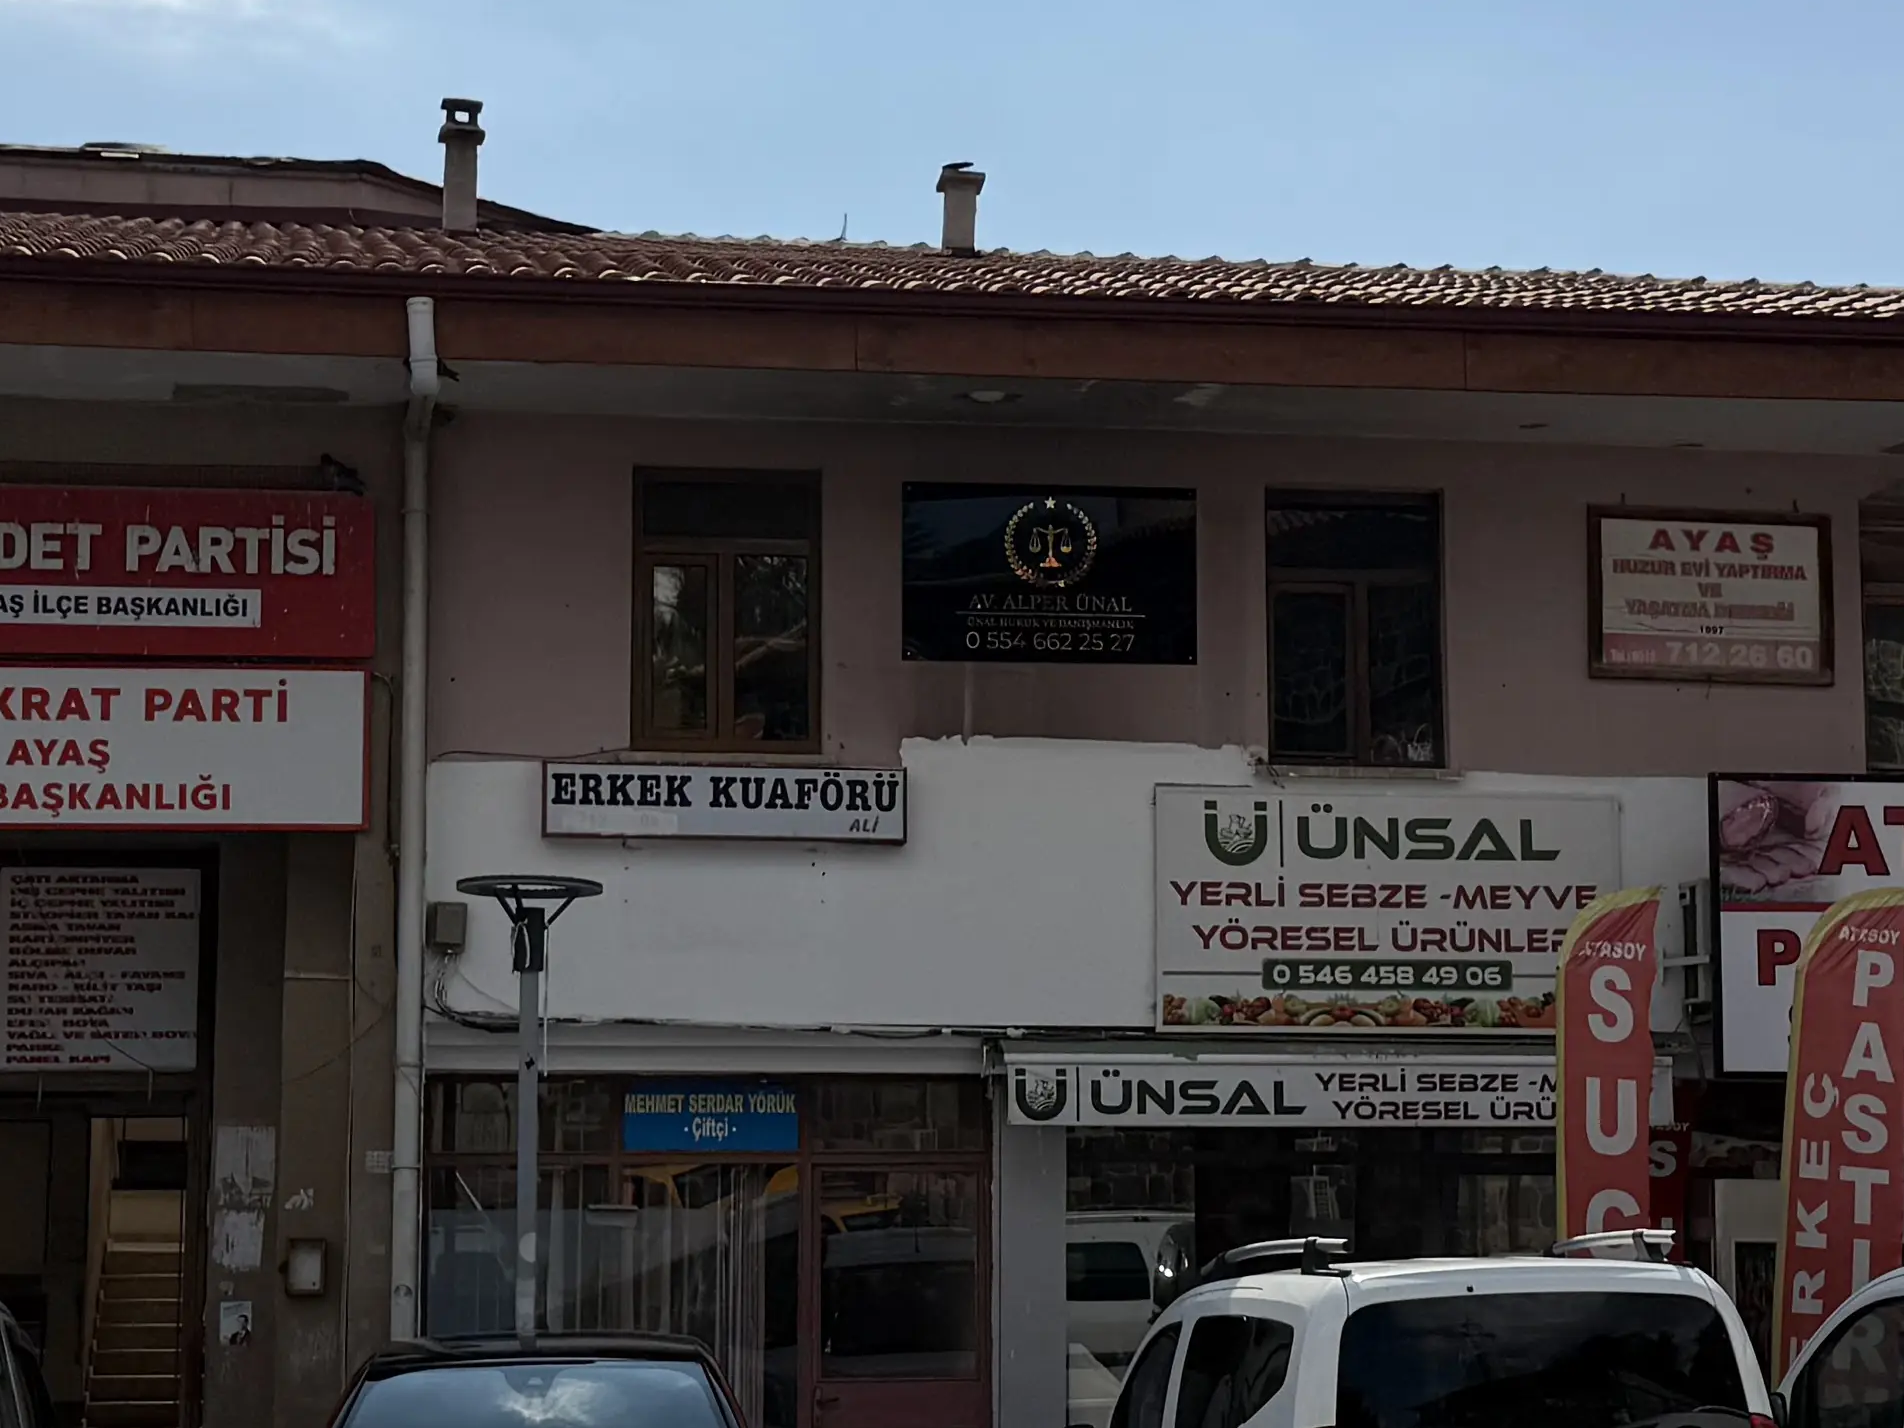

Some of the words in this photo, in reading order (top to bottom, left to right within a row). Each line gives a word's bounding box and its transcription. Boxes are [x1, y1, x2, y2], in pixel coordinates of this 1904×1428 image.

[126, 514, 336, 575] PARTİSİ
[1649, 529, 1775, 560] AYAŞ
[33, 589, 89, 620] İLÇE
[97, 592, 248, 622] BAŞKANLIĞI
[1003, 594, 1069, 611] ALPER
[1076, 592, 1133, 612] ÜNAL
[966, 631, 980, 649] 0
[1033, 633, 1073, 651] 662
[1079, 633, 1104, 652] 25
[1110, 633, 1136, 653] 27
[1665, 641, 1720, 665] 712
[144, 678, 289, 723] PARTİ
[5, 738, 111, 774] AYAŞ
[551, 772, 693, 808] ERKEK
[709, 771, 899, 812] KUAFÖRÜ
[1297, 803, 1562, 862] ÜNSAL
[1170, 875, 1287, 909] YERLİ
[1298, 882, 1429, 910] SEBZE
[1191, 918, 1380, 952] YÖRESEL
[1273, 965, 1291, 985] 0
[1299, 966, 1352, 985] 546
[1360, 966, 1415, 985] 458
[1421, 966, 1459, 986] 49
[1465, 966, 1503, 986] 06
[1092, 1069, 1308, 1118] ÜNSAL
[1315, 1069, 1408, 1094] YERLİ
[1416, 1072, 1519, 1094] SEBZE
[624, 1093, 685, 1115] MEHMET
[688, 1092, 745, 1115] SERDAR
[748, 1090, 797, 1115] YÖRÜK
[1332, 1096, 1481, 1121] YÖRESEL
[691, 1116, 729, 1142] Çiftçi
